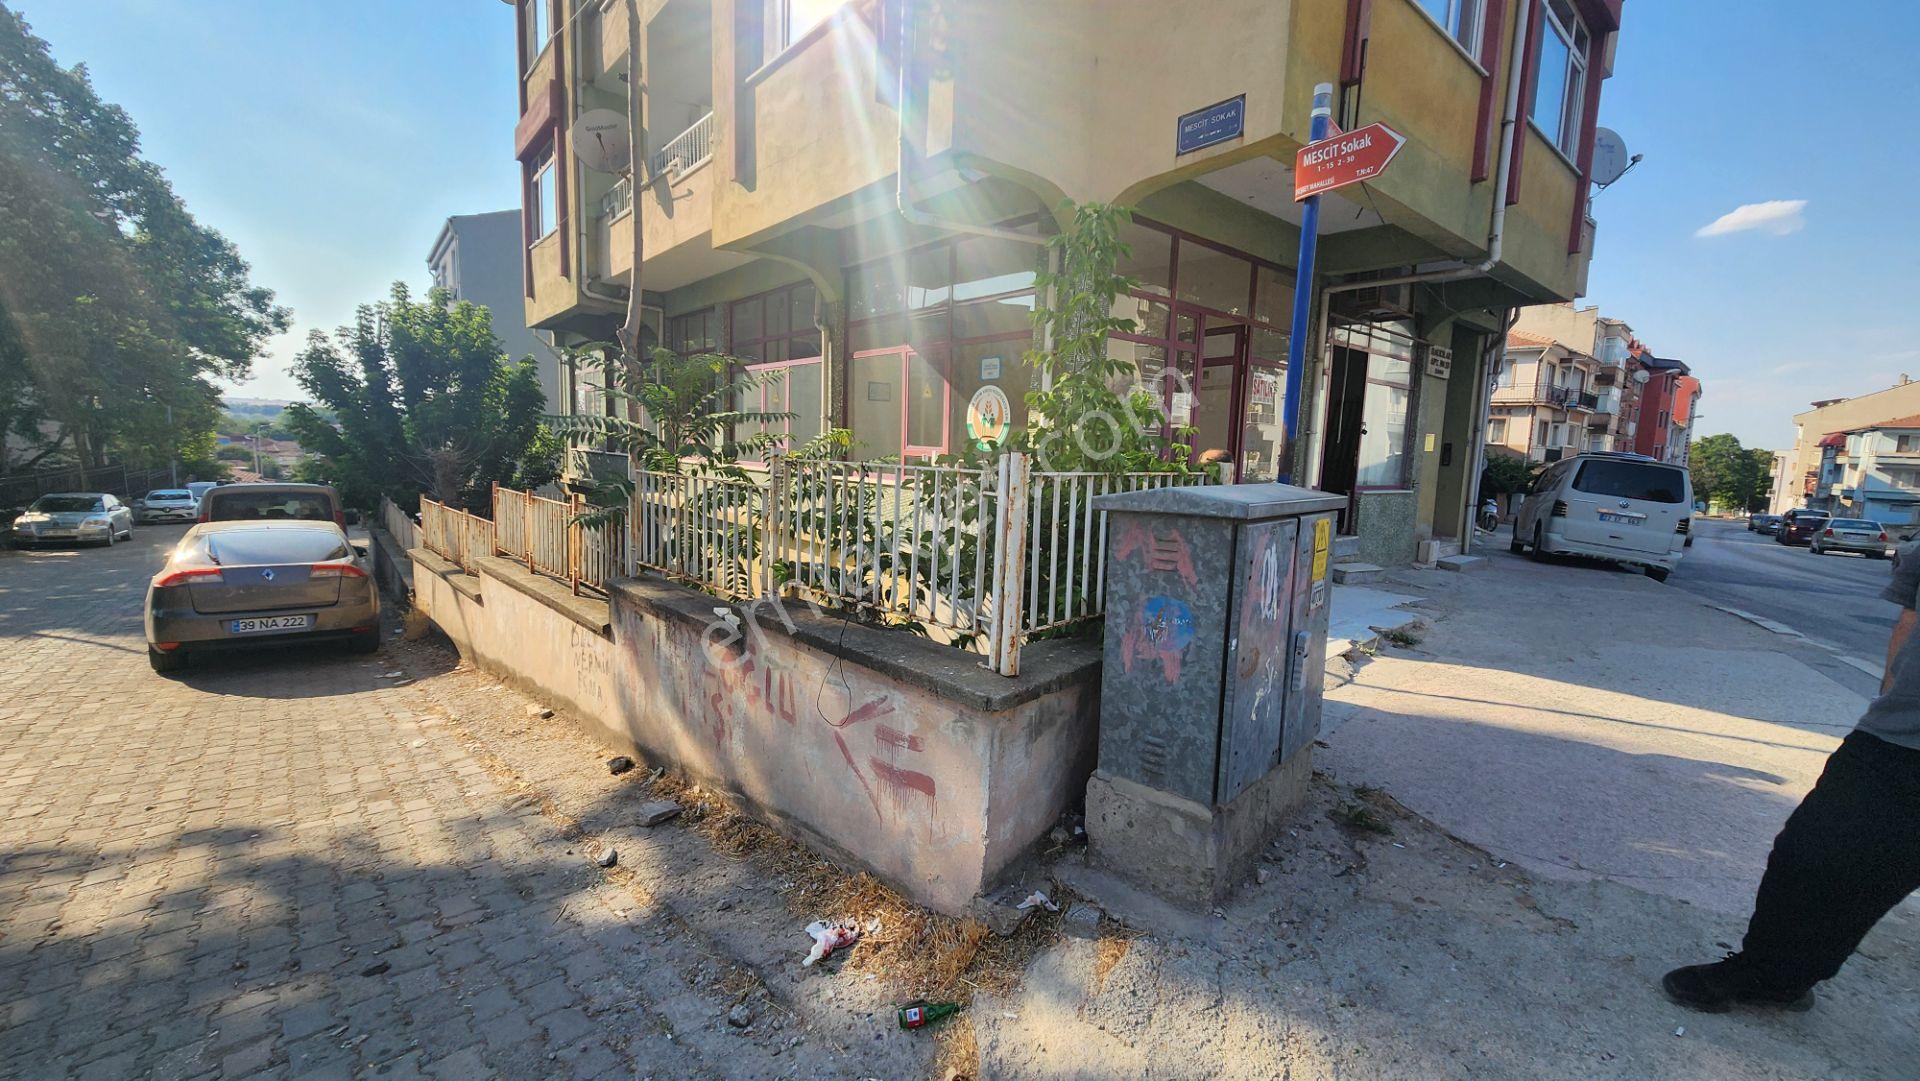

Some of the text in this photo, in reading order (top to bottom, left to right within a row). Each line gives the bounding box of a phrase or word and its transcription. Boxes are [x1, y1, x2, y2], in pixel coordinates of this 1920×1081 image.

[1211, 110, 1236, 124] SOKAK
[1303, 133, 1372, 168] MESCİT Sokak
[240, 617, 304, 631] 39 NA 222
